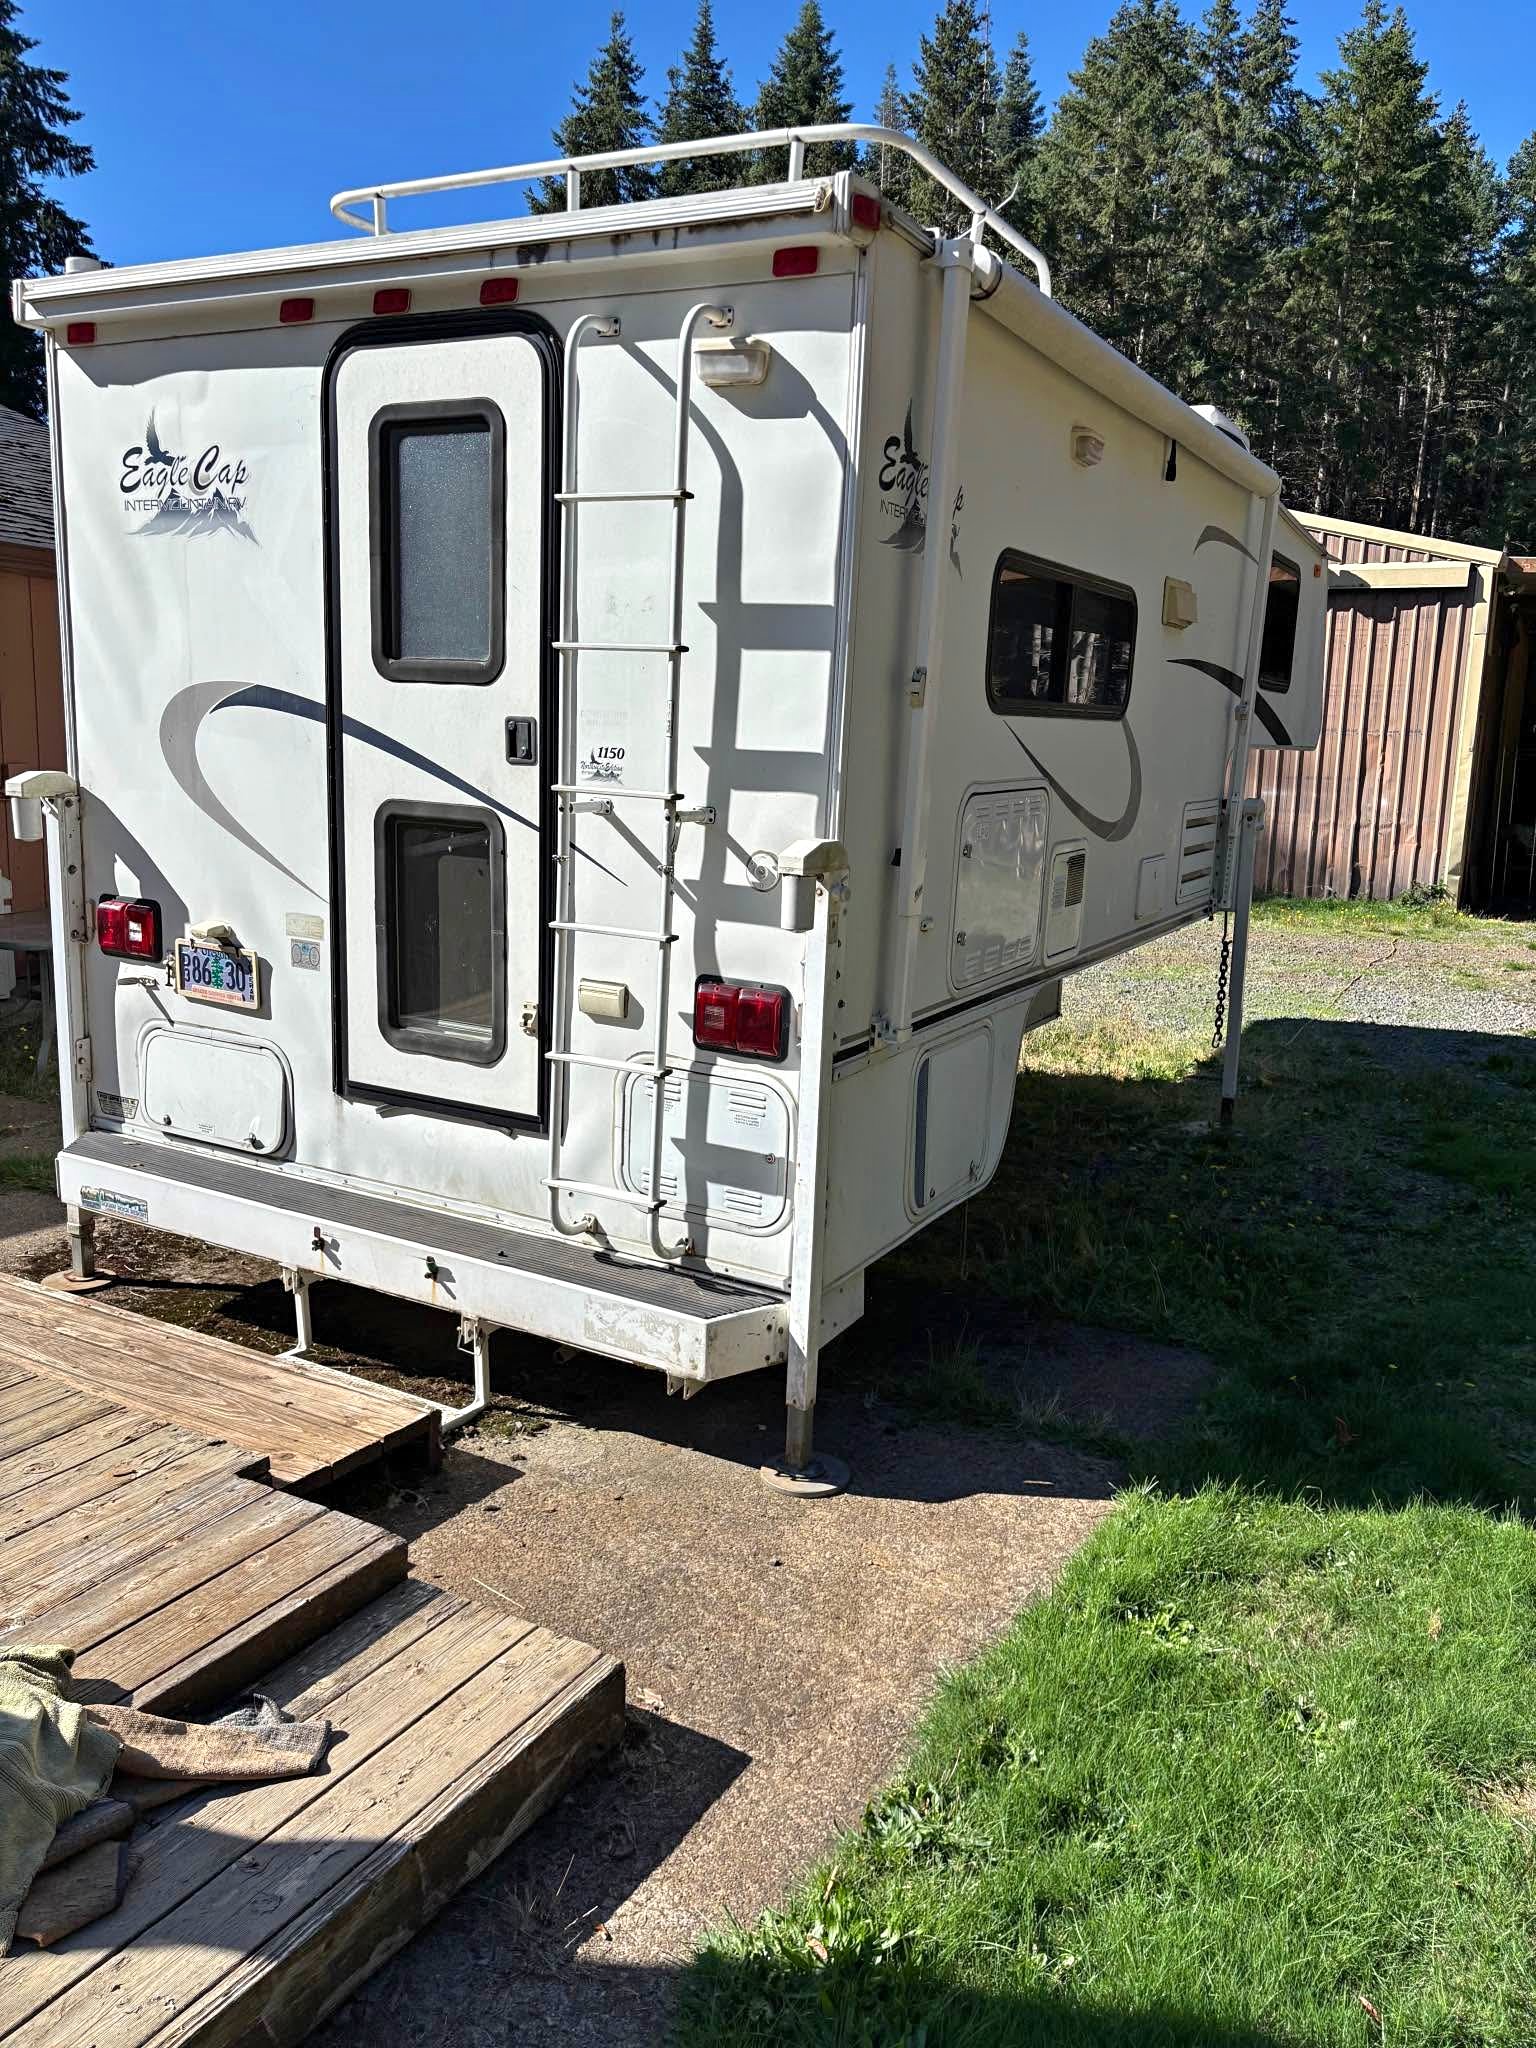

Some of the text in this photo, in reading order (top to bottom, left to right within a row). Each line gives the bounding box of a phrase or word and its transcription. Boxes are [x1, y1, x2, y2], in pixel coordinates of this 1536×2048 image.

[120, 444, 248, 498] Eagle Cap
[879, 436, 929, 506] Eagle
[598, 747, 625, 760] 1150
